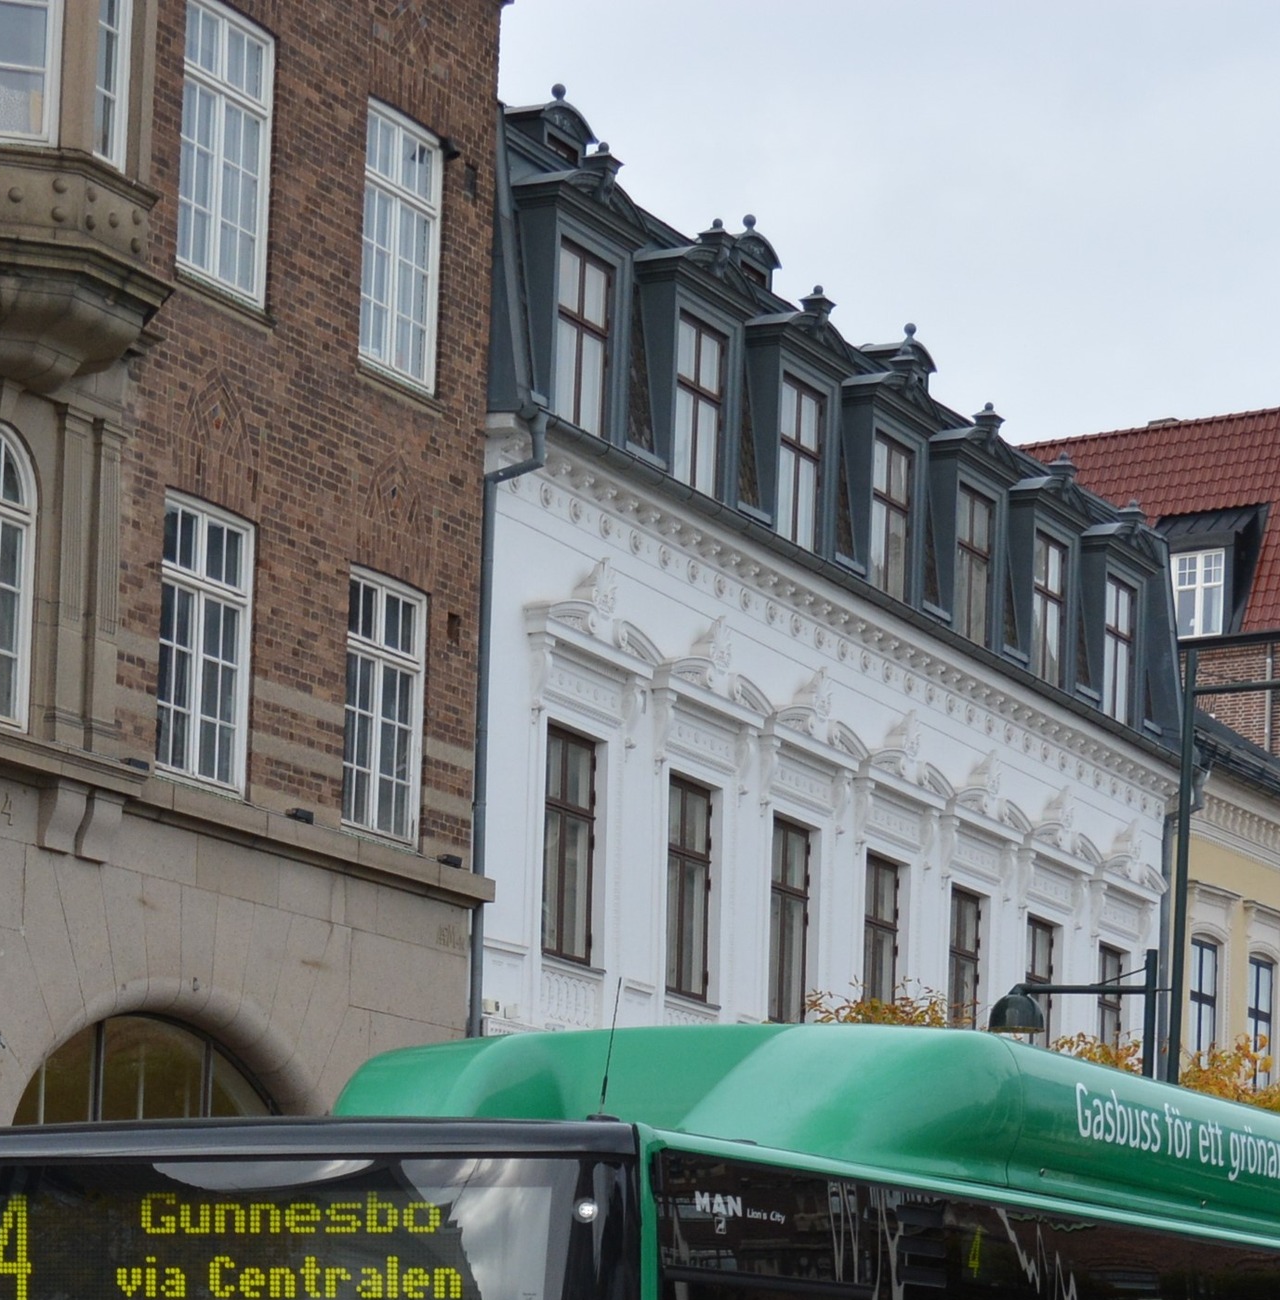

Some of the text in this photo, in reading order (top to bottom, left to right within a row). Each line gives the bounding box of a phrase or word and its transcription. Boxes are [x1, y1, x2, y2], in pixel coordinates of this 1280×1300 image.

[1075, 1081, 1162, 1154] Gasbuss
[1164, 1102, 1192, 1159] för
[1198, 1119, 1225, 1168] ett
[141, 1191, 441, 1234] Gunnesbo
[694, 1190, 743, 1218] MAN
[769, 1210, 786, 1225] City
[117, 1255, 463, 1300] via Centralen
